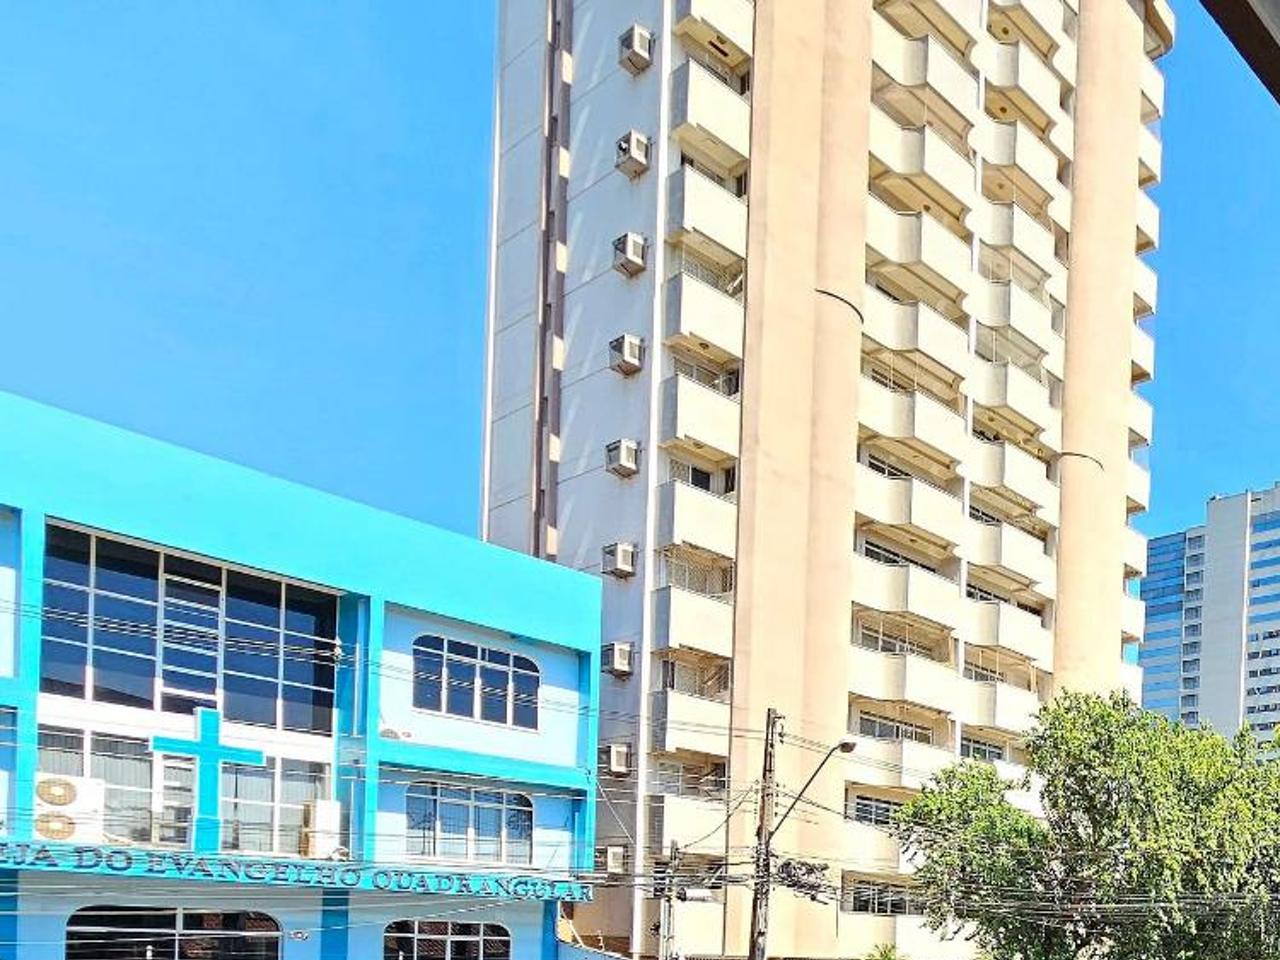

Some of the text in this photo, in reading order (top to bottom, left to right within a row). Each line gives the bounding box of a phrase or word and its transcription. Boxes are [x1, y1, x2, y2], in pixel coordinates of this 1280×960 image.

[73, 846, 133, 871] DO
[146, 852, 361, 887] EVANGELHO
[372, 869, 592, 901] QUADRANGULAR
